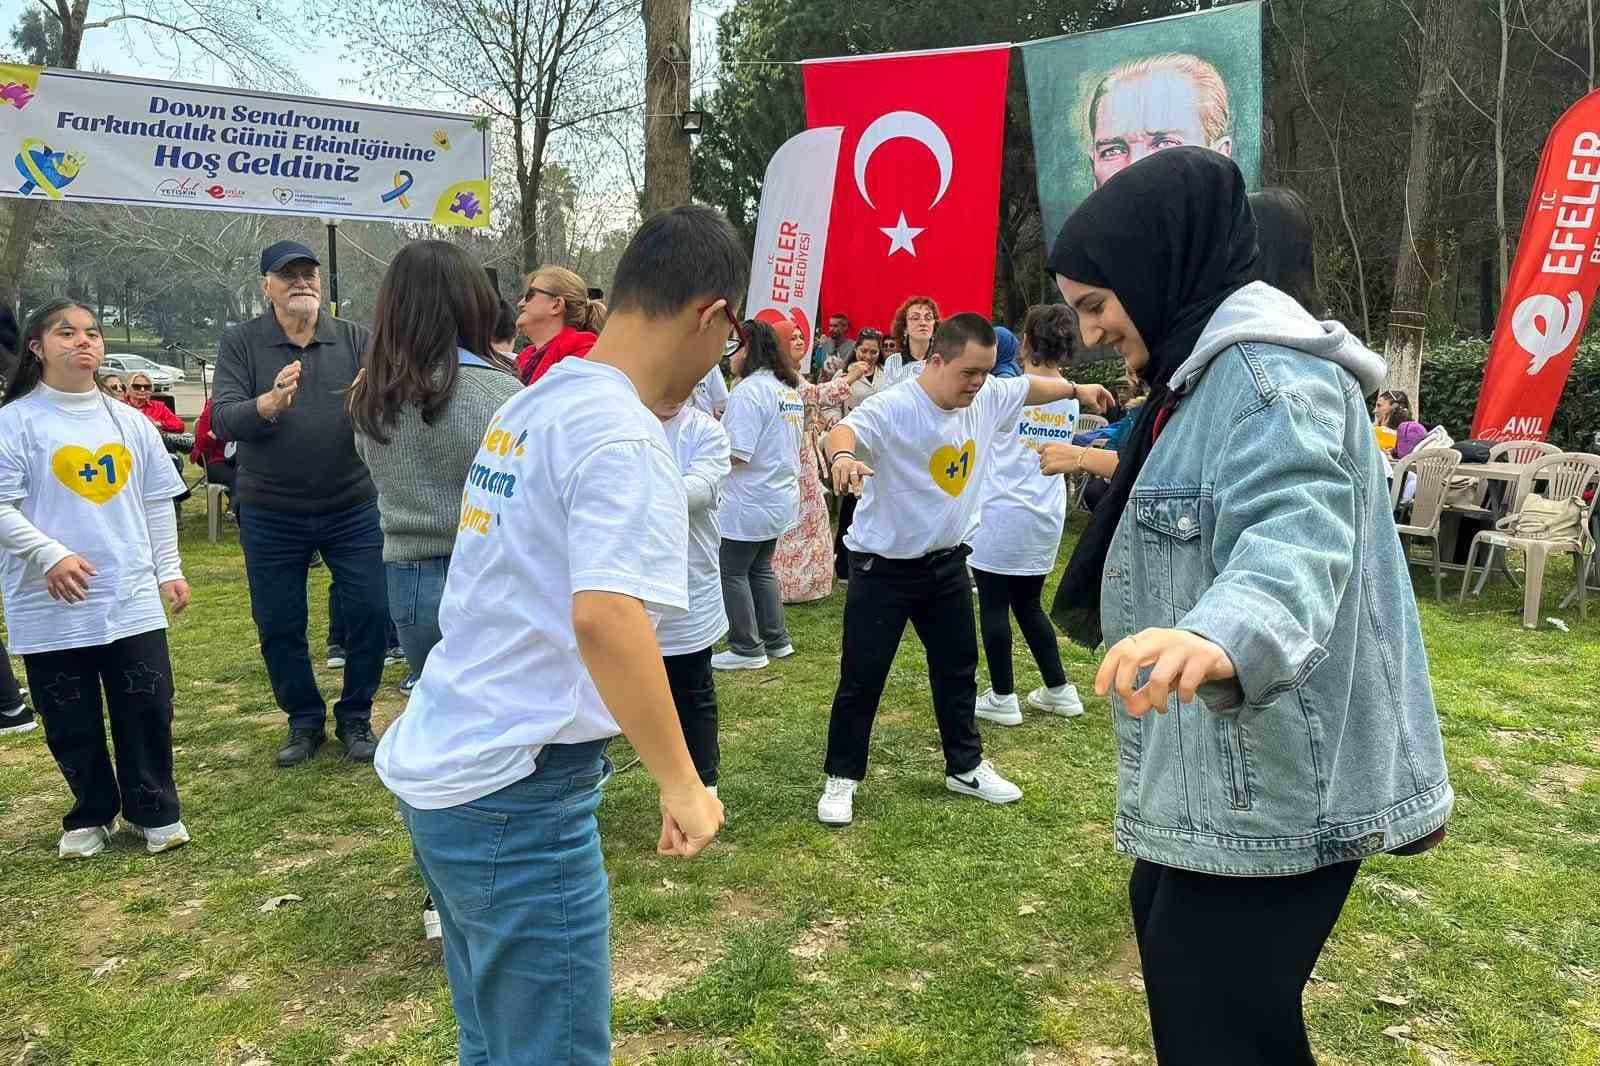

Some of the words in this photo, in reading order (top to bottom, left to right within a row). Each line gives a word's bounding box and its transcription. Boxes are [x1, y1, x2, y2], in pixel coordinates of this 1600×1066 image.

[149, 96, 226, 121] Down
[231, 104, 361, 134] Sendromu
[56, 111, 217, 142] Farkındalık
[220, 126, 288, 150] Günü
[291, 133, 437, 163] Etkinliğinine
[154, 144, 222, 179] Hoş
[227, 150, 361, 183] Geldiniz
[1538, 189, 1558, 212] T.C.
[1541, 131, 1600, 275] EFELER
[771, 220, 799, 304] EFELER
[793, 232, 811, 298] BELEDİYESİ
[1031, 407, 1066, 426] Sevgi
[1501, 416, 1543, 435] ANIL
[78, 454, 117, 485] +1
[945, 451, 969, 479] +1
